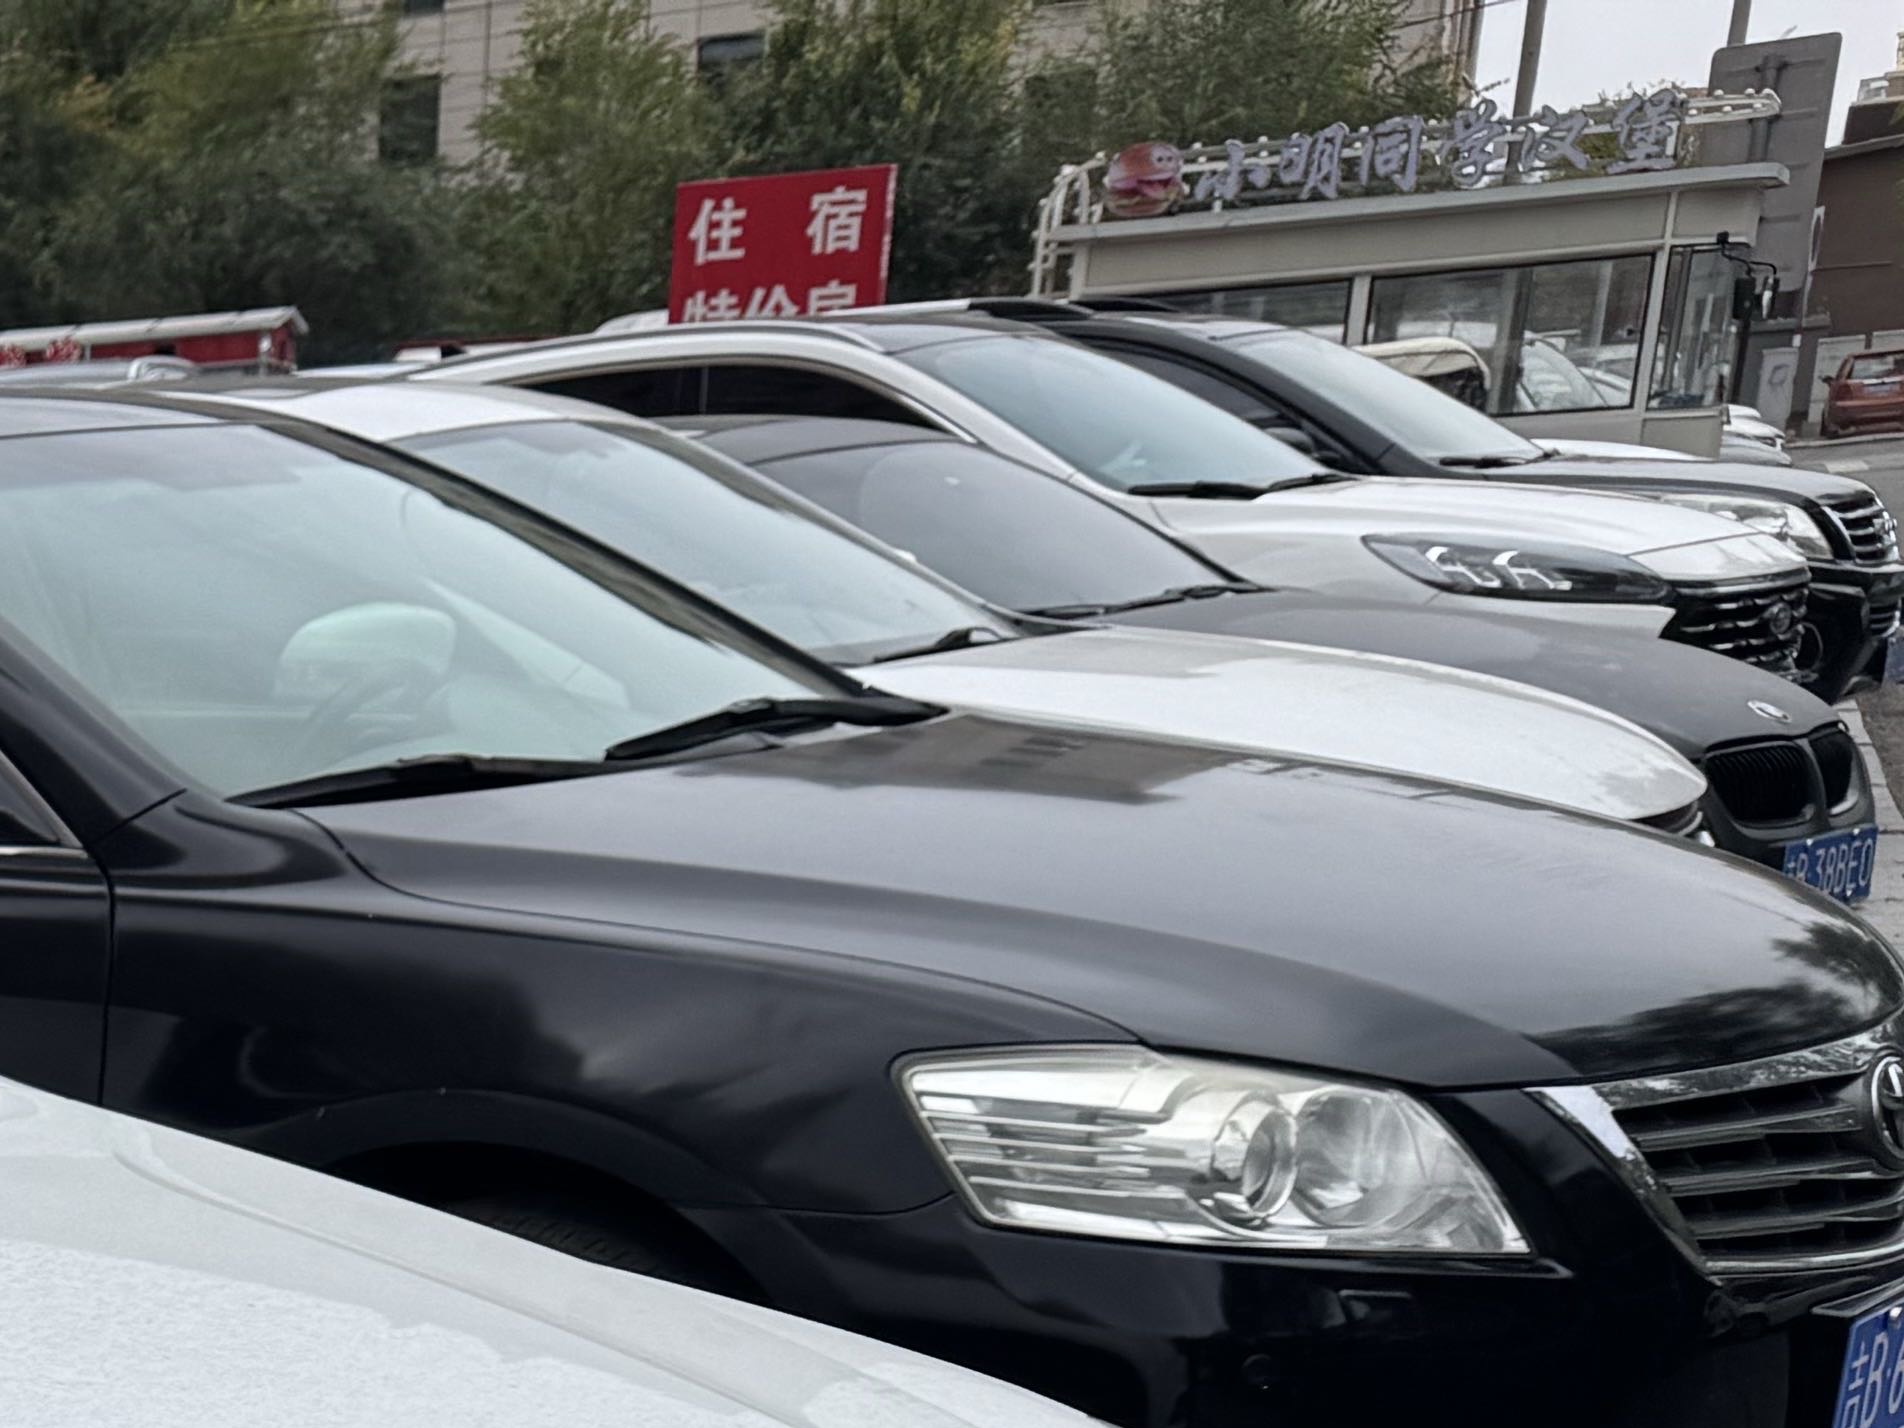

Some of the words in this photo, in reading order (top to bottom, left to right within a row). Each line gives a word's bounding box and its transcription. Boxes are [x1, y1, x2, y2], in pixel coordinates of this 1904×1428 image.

[1195, 87, 1689, 201] 小明同学汉堡
[688, 185, 869, 267] 住宿
